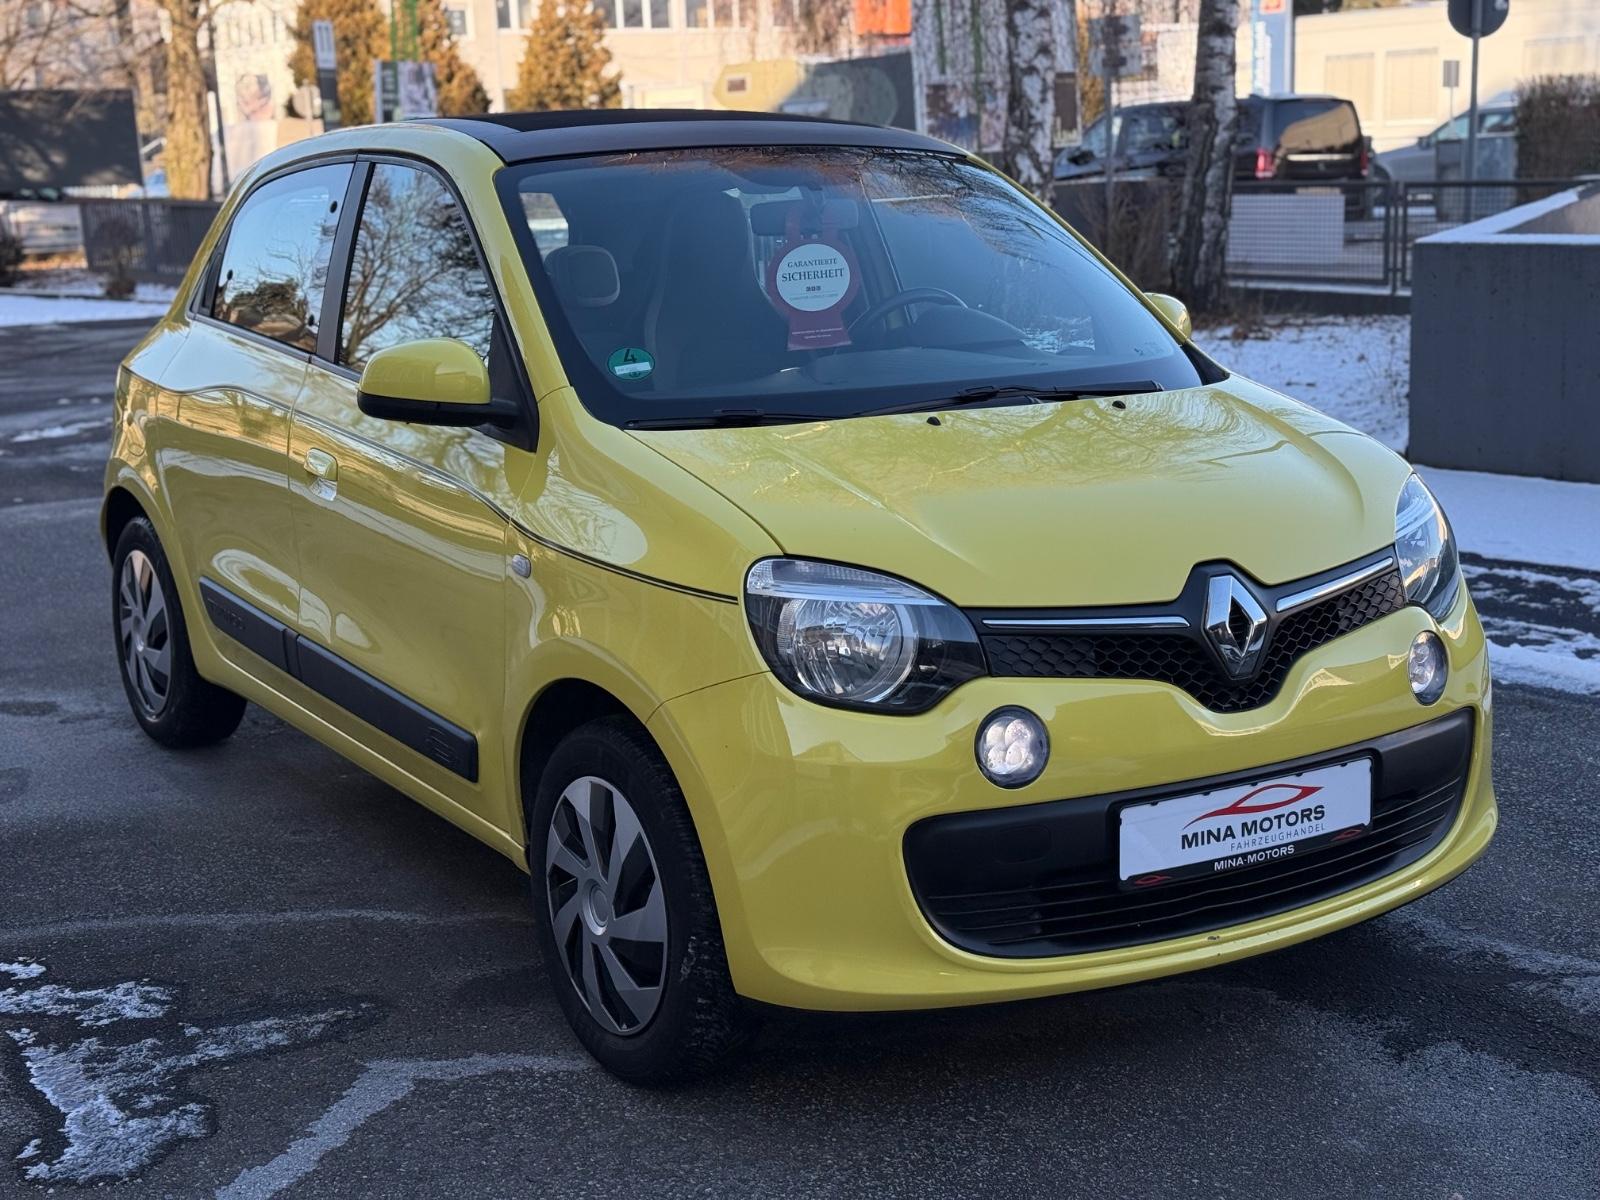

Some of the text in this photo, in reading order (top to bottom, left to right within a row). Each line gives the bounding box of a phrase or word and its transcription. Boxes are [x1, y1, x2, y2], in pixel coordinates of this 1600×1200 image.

[787, 258, 837, 268] GARANTIERTE
[781, 268, 844, 282] SICHERHEIT
[624, 349, 637, 362] 4
[1181, 804, 1326, 850] MINA MOTORS
[1230, 824, 1326, 852] FAHRZEUGHANDEL
[1214, 844, 1295, 871] MINA-MOTORS
